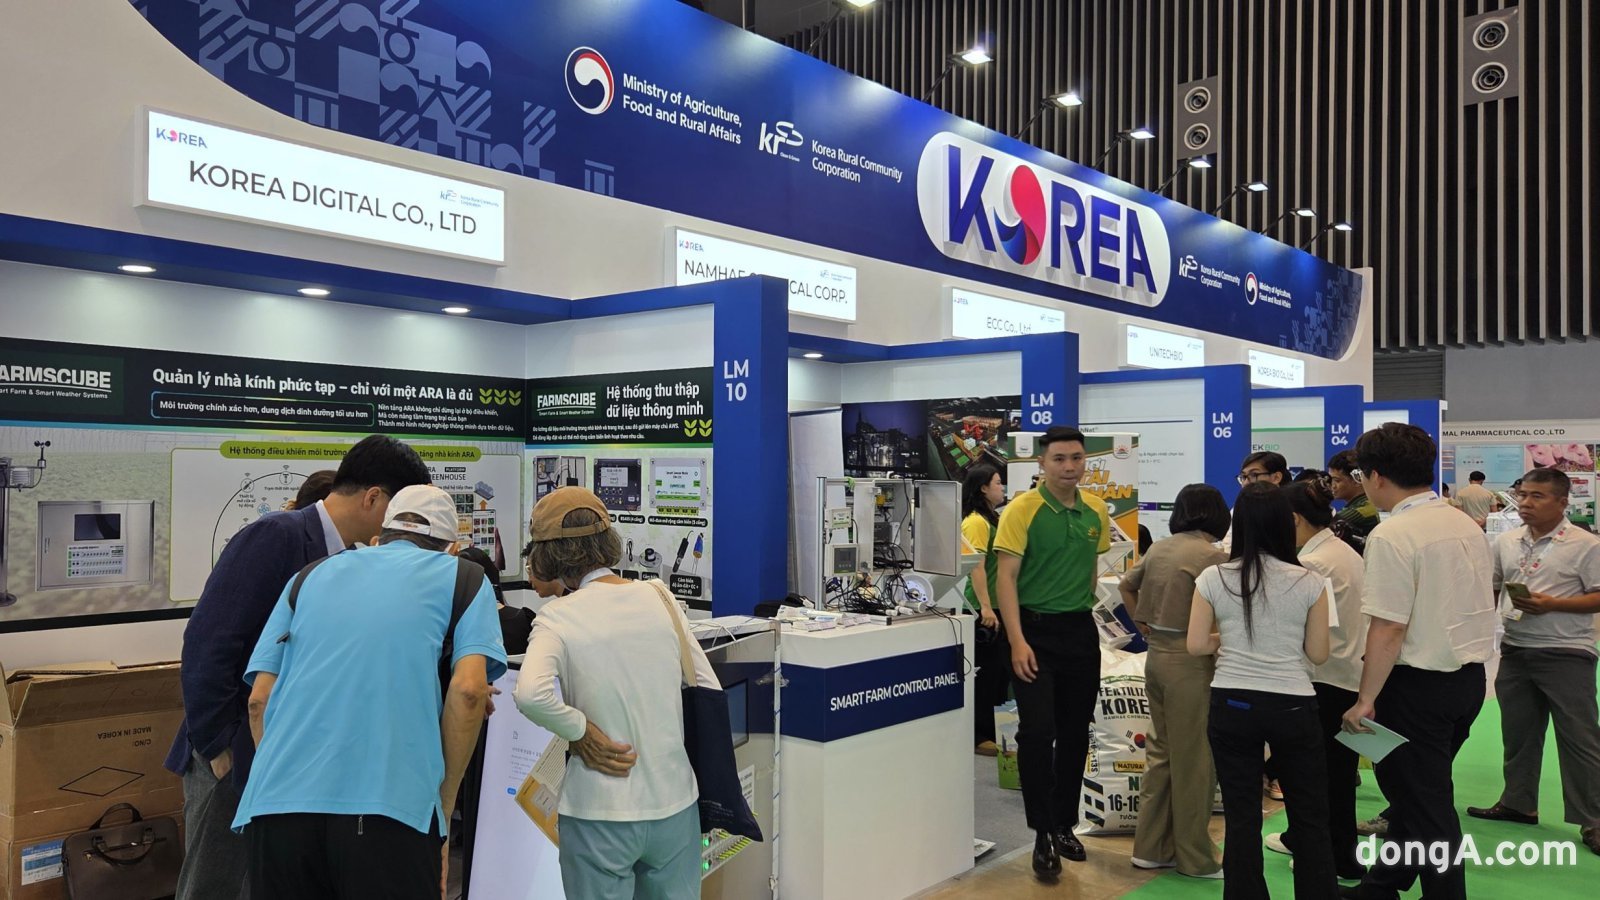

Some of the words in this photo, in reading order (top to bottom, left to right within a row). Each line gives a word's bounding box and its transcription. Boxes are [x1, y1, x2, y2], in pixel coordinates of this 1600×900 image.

[623, 73, 669, 104] Ministry
[670, 91, 683, 106] of
[684, 94, 743, 129] Agriculture,
[623, 94, 653, 117] Food
[656, 104, 678, 125] and
[680, 110, 707, 134] Rural
[709, 120, 742, 146] Affairs
[156, 127, 209, 149] KOREA
[812, 140, 837, 160] Korea
[838, 148, 859, 166] Rural
[860, 156, 903, 184] Community
[812, 157, 861, 183] Corporation
[189, 160, 287, 200] KOREA
[292, 181, 389, 219] DIGITAL
[392, 202, 435, 232] CO.,
[439, 211, 478, 235] LTD
[945, 144, 1159, 295] KOREA
[679, 239, 705, 253] KOREA
[1200, 275, 1223, 289] Corporation
[1201, 264, 1212, 275] Korea
[1212, 267, 1222, 277] Rural
[1221, 270, 1241, 287] Community
[815, 285, 849, 305] CORP.
[986, 316, 1004, 331] ECC
[0, 364, 112, 389] ARMSCUBE
[723, 358, 750, 380] LM
[152, 367, 194, 385] Quản
[197, 371, 210, 389] lý
[214, 373, 242, 388] nhà
[245, 374, 276, 390] kính
[278, 378, 313, 394] phức
[314, 381, 337, 397] tạp
[350, 381, 370, 396] chỉ
[372, 384, 391, 397] với
[393, 385, 417, 400] một
[418, 386, 444, 400] ARA
[446, 388, 457, 401] là
[458, 388, 474, 401] đủ
[606, 385, 621, 401] Hệ
[622, 383, 653, 402] thống
[654, 383, 674, 398] thu
[674, 382, 700, 399] thập
[725, 382, 748, 402] 10
[35, 389, 55, 397] Smart
[56, 391, 82, 399] Weather
[83, 392, 109, 400] Systems
[536, 391, 597, 409] FARMSCUBE
[1030, 392, 1055, 408] LM
[159, 401, 176, 410] Môi
[177, 402, 205, 412] trường
[205, 403, 228, 413] chính
[228, 404, 242, 413] xác
[243, 405, 260, 415] hơn,
[261, 406, 280, 416] dung
[606, 403, 620, 418] dữ
[622, 404, 639, 420] liệu
[642, 403, 674, 420] thông
[675, 400, 705, 416] minh
[1031, 410, 1053, 426] 08
[1212, 411, 1234, 425] LM
[1213, 426, 1233, 440] 06
[1330, 424, 1350, 435] LM
[1460, 429, 1532, 437] PHARMACEUTICAL
[1264, 443, 1281, 452] BIO
[1331, 435, 1349, 447] 04
[229, 446, 242, 456] Hệ
[432, 473, 467, 481] EENHOUSE
[830, 691, 865, 712] SMART
[865, 686, 893, 704] FARM
[892, 678, 934, 697] CONTROL
[934, 671, 960, 689] PANEL
[1100, 686, 1145, 697] FERTILIZ
[1101, 697, 1150, 716] KORE
[97, 729, 123, 740] KOREA
[124, 728, 132, 737] IN
[132, 726, 152, 737] MADE
